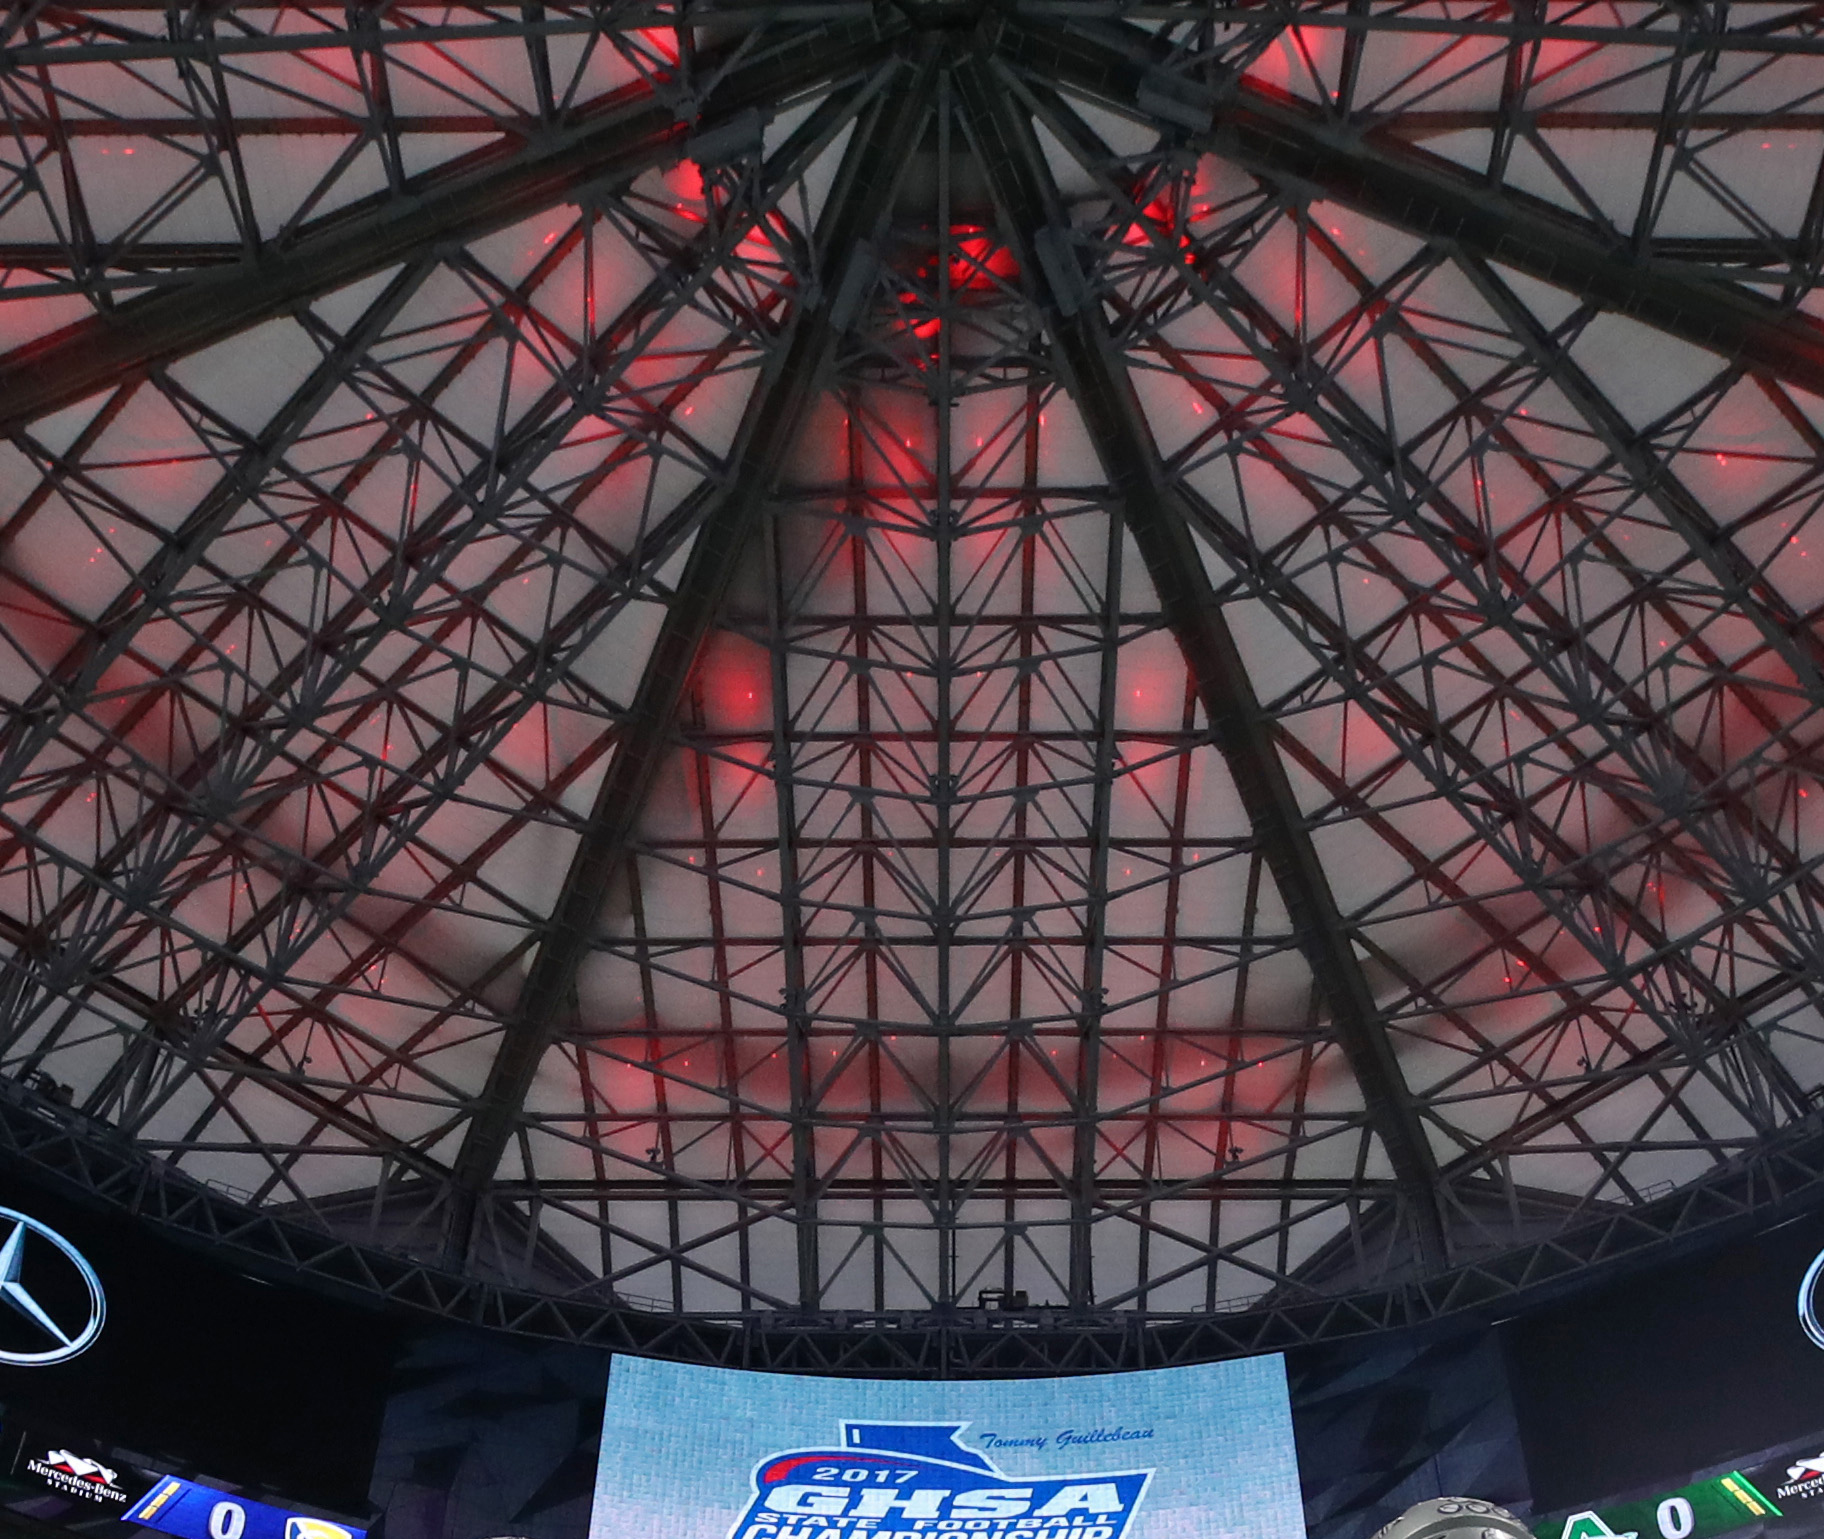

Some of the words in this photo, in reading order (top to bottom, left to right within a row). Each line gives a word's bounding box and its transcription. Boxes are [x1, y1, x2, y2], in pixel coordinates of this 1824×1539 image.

[979, 1431, 1049, 1451] Tommy
[1055, 1426, 1156, 1449] Guillebeau
[26, 1458, 128, 1504] Mercedes-Benz
[812, 1466, 919, 1484] 2017
[46, 1478, 104, 1503] STADIUM
[763, 1483, 1126, 1519] GHSA
[752, 1512, 882, 1529] STATE
[913, 1516, 1118, 1530] FOOTBALL
